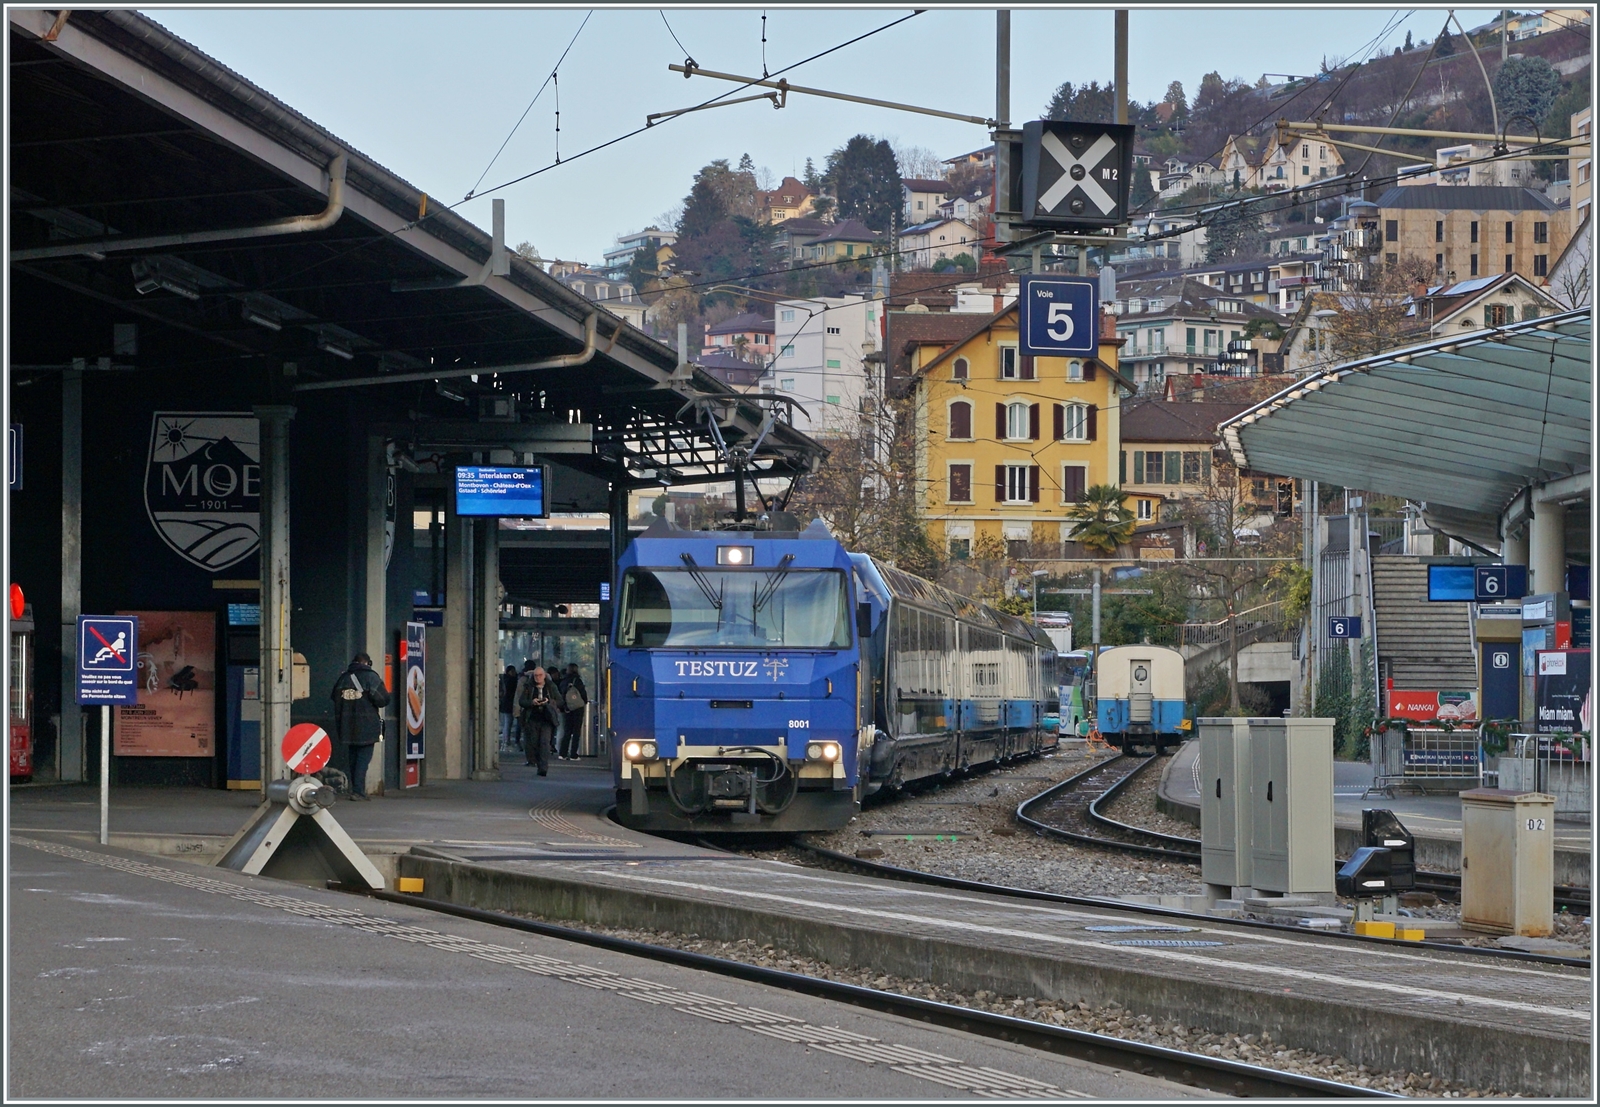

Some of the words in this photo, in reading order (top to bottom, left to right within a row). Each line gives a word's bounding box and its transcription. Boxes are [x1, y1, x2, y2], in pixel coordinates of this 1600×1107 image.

[1036, 289, 1054, 298] Voie
[1047, 302, 1075, 342] 5
[512, 472, 525, 480] Ost
[200, 500, 228, 510] 1901
[1485, 576, 1499, 594] 6
[1335, 623, 1344, 635] 6
[674, 660, 758, 677] TESTUZ
[1407, 703, 1435, 712] NANKAI
[1539, 706, 1556, 720] Miam
[1556, 706, 1575, 721] miam.
[788, 719, 810, 729] 8001
